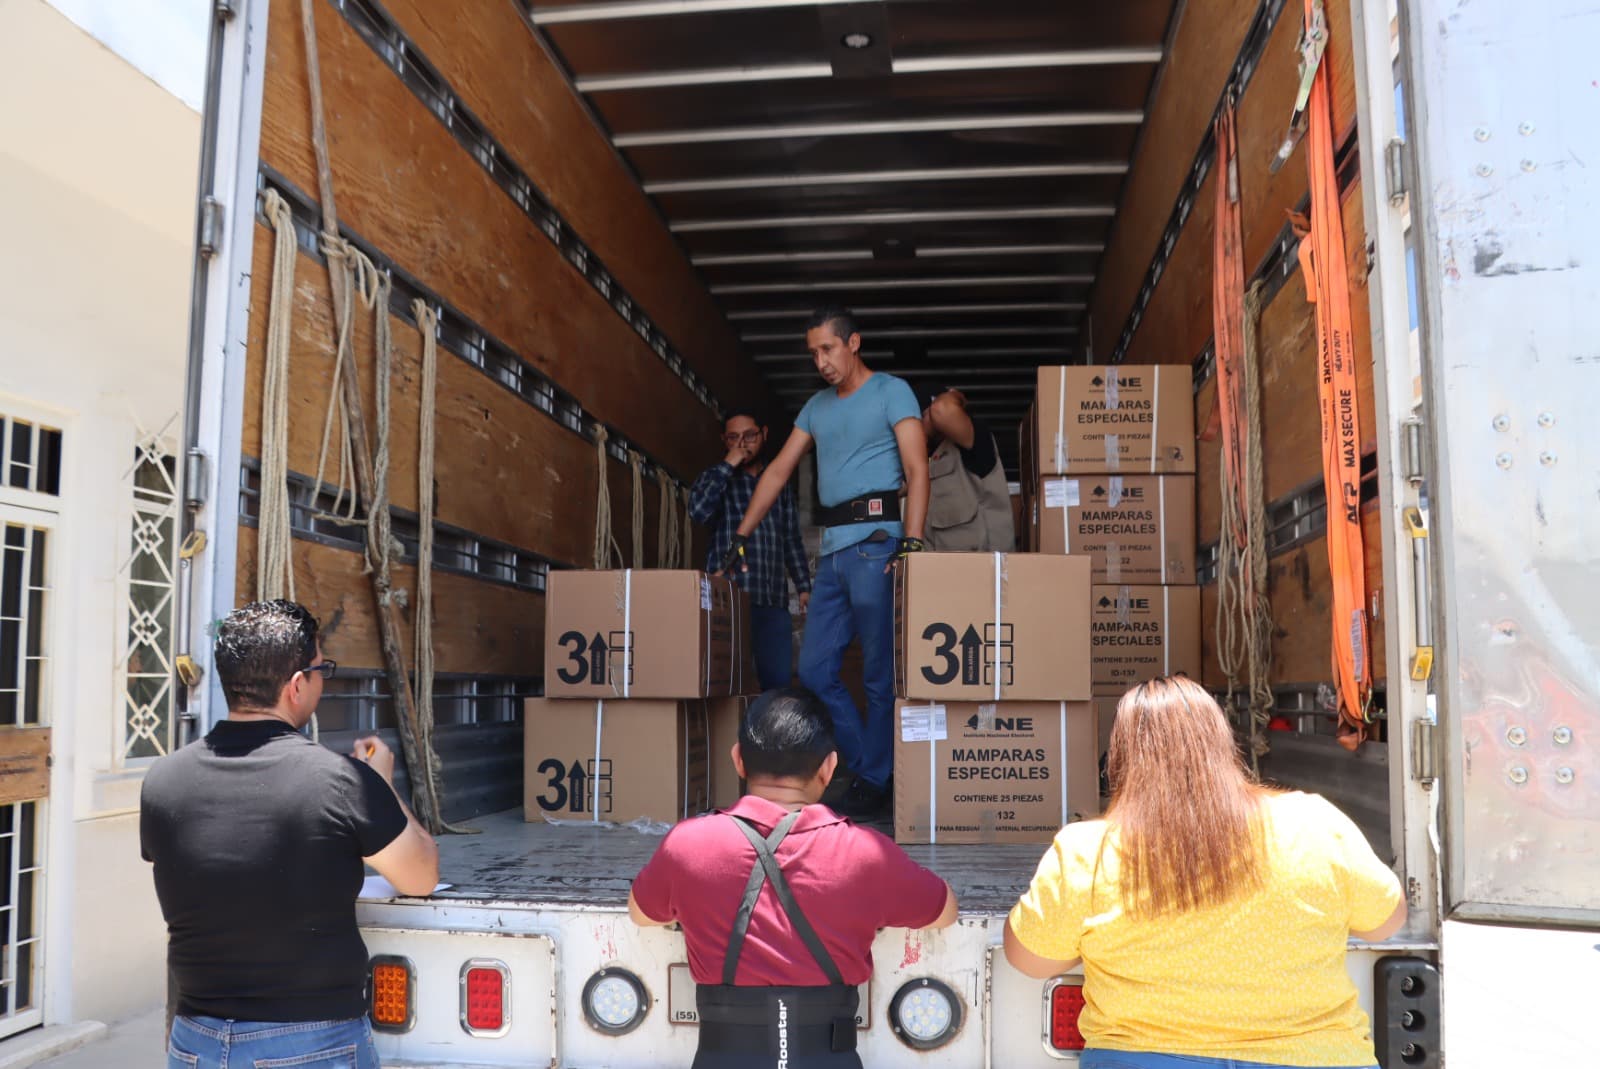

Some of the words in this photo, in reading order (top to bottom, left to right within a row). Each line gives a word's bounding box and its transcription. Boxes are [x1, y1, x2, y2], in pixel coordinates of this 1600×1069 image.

[1080, 400, 1151, 410] MAMARAS
[1078, 413, 1154, 424] ESPECIALES
[1340, 389, 1353, 437] SECURE
[1344, 440, 1355, 467] MAX
[1082, 510, 1153, 521] MAMPARAS
[1078, 524, 1156, 534] ESPECIALES
[1092, 636, 1162, 646] SPECIALES
[556, 630, 589, 684] 3
[920, 622, 960, 685] 3
[984, 718, 1033, 731] NE
[952, 749, 1045, 762] MAMPARAS
[948, 767, 1049, 780] ESPECIALES
[536, 758, 567, 811] 3
[953, 794, 999, 803] CONTIENE
[1000, 795, 1010, 803] 25
[1012, 794, 1044, 802] PIEZAS
[675, 1011, 697, 1021] (55)
